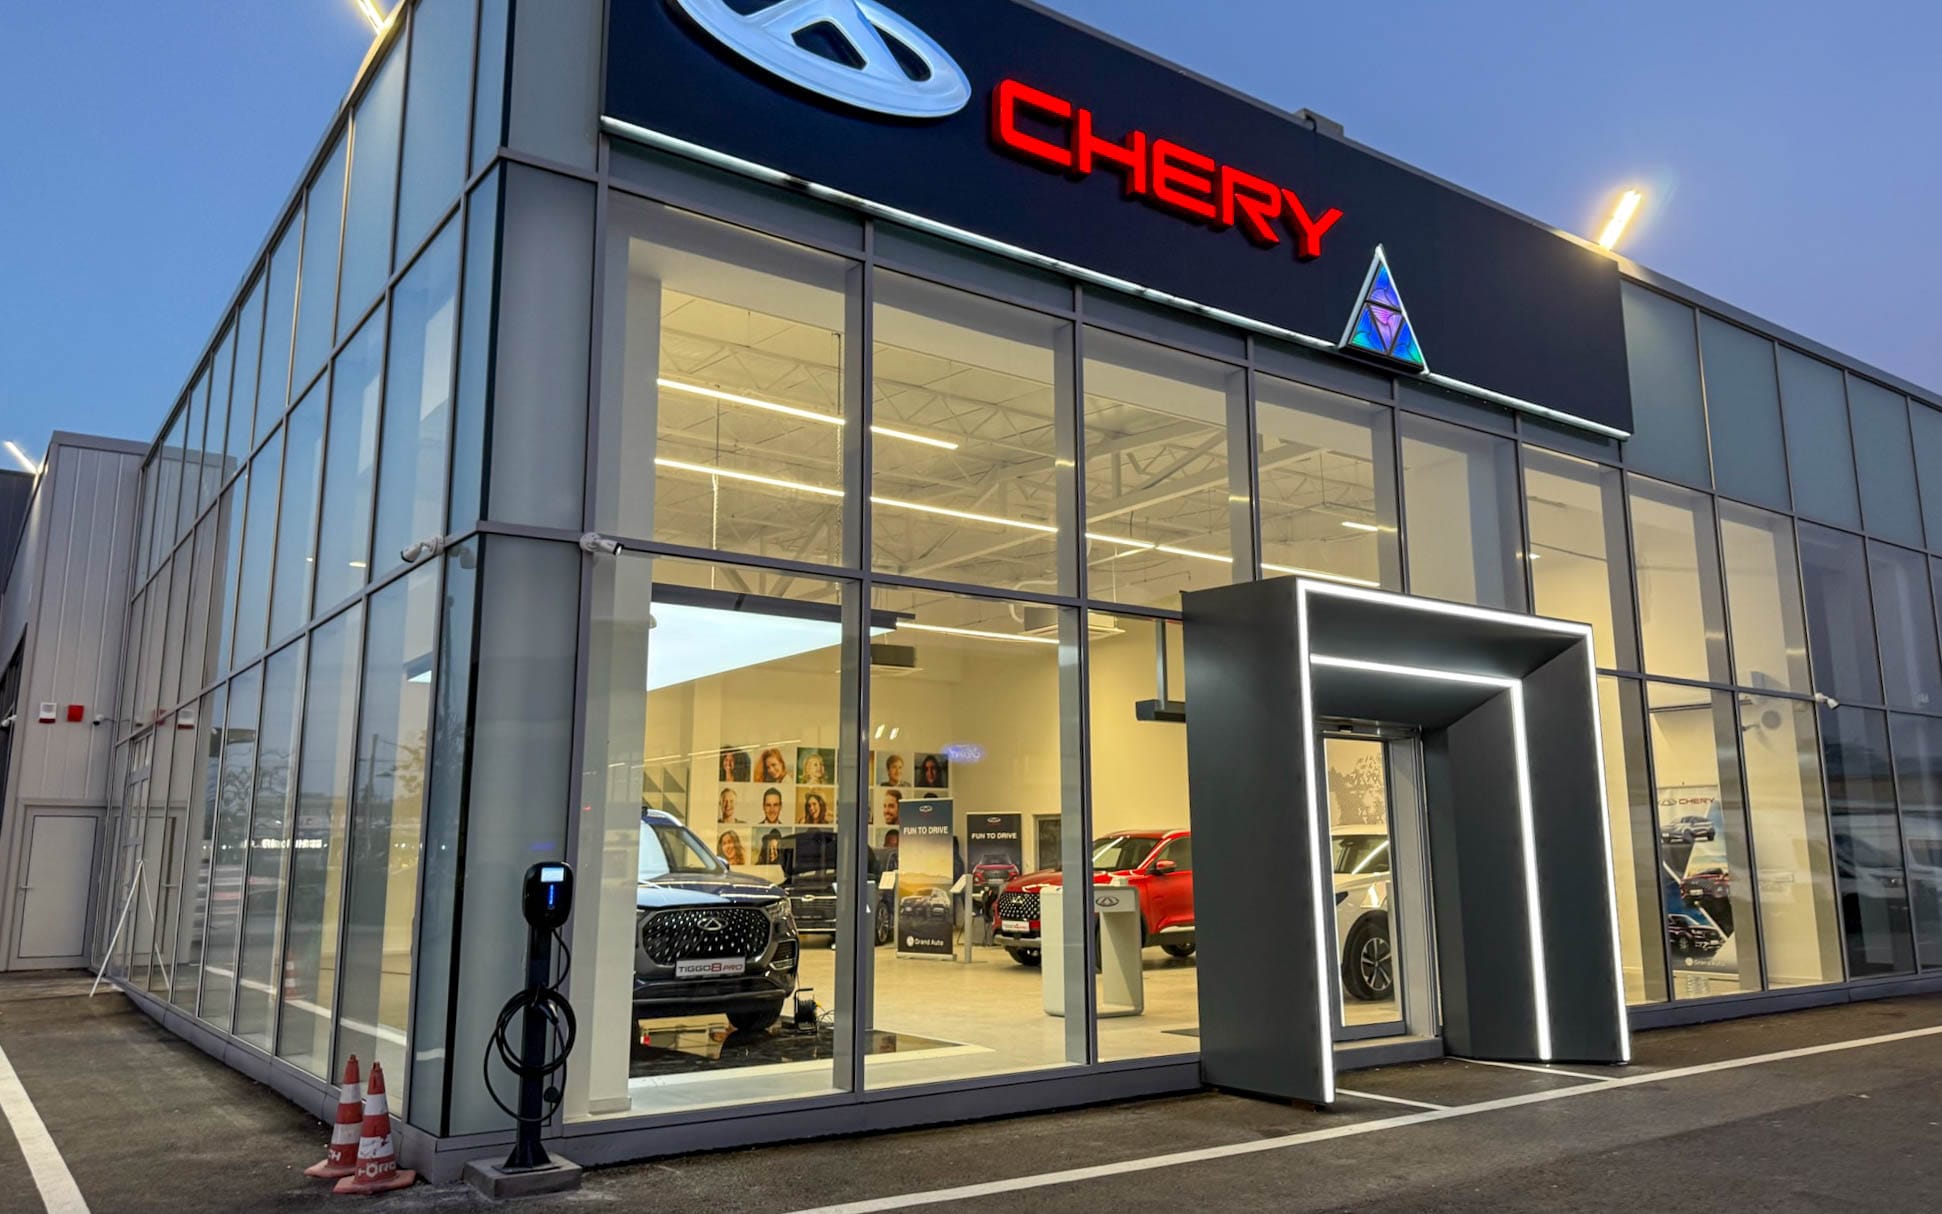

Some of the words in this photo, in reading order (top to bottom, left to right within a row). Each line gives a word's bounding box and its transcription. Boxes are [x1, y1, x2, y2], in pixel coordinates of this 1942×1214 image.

[993, 78, 1344, 258] CHERY
[1679, 797, 1715, 805] CHERY
[903, 826, 917, 835] FUN
[918, 826, 927, 834] TO
[928, 825, 948, 834] DRIVE
[971, 832, 985, 840] FUN
[987, 832, 996, 840] TO
[997, 832, 1017, 840] DRIVE
